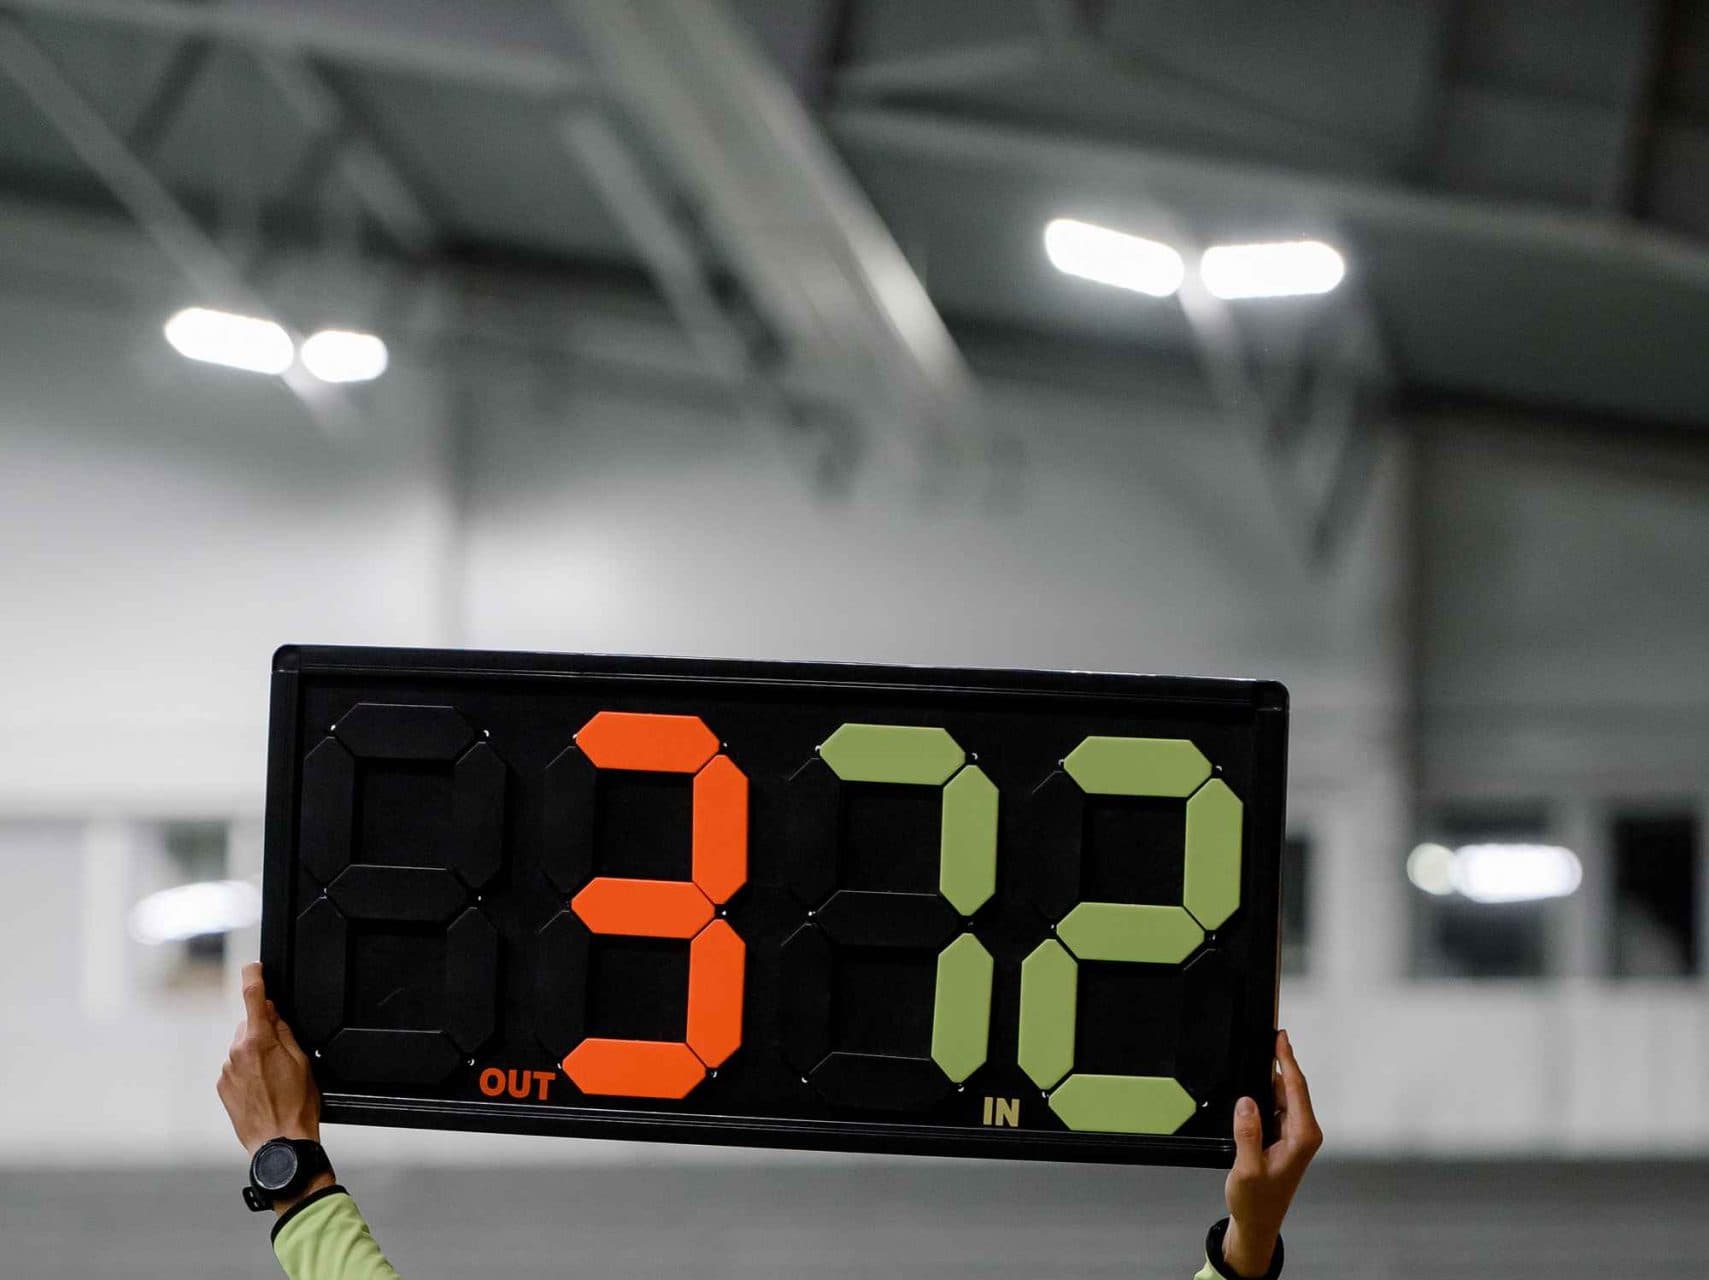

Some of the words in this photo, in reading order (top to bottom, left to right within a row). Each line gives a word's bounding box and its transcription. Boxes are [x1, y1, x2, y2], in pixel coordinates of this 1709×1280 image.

[562, 711, 748, 1099] 3
[818, 722, 1243, 1135] 72
[480, 1067, 556, 1101] OUT
[983, 1096, 1020, 1127] IN
